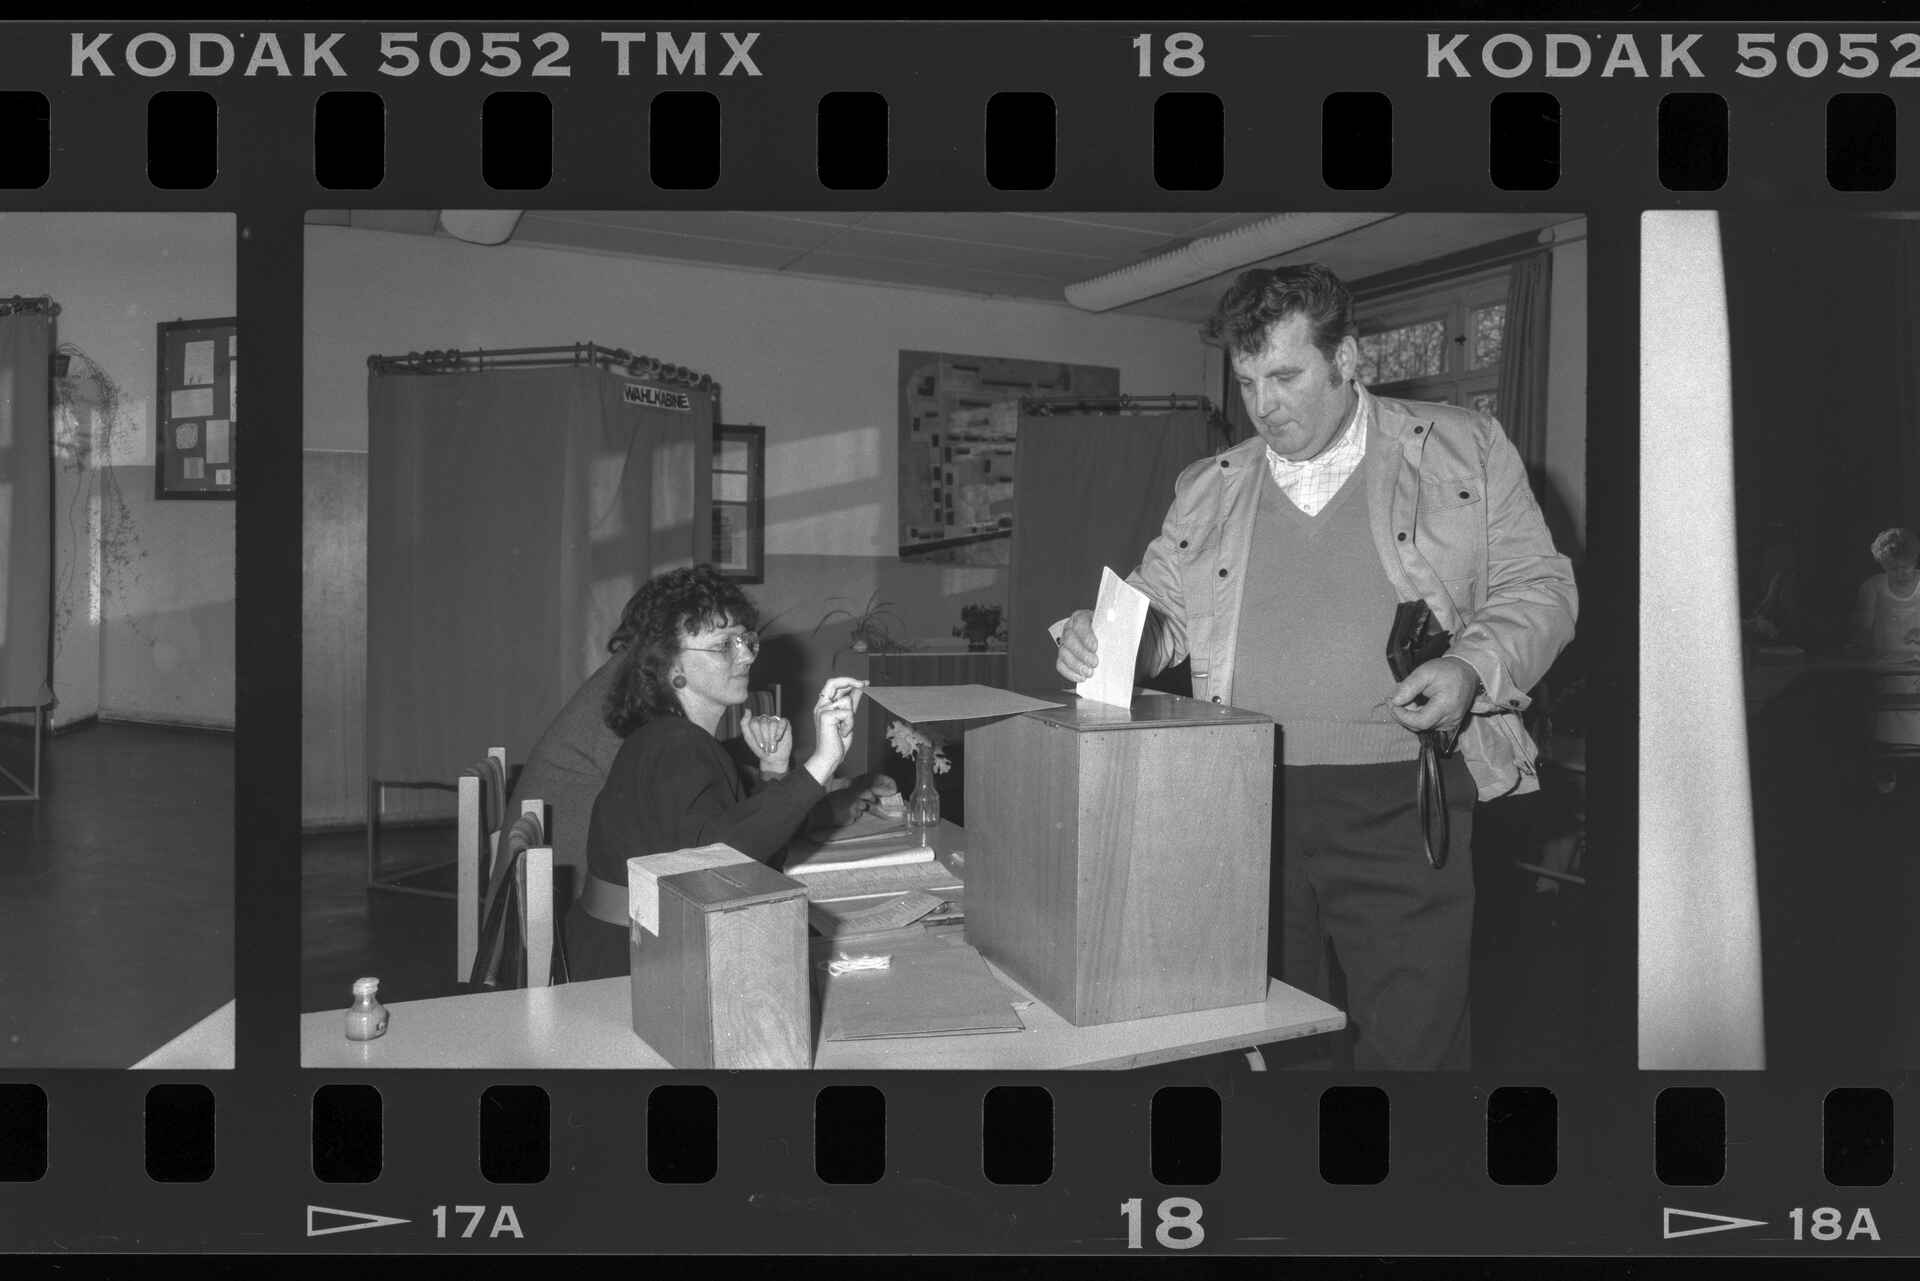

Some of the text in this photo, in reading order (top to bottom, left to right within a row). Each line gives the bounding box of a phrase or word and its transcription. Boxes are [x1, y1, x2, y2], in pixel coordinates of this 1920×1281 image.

[71, 31, 762, 77] KODAK 5052 TMX
[1133, 32, 1205, 77] 18
[1427, 32, 1920, 78] KODAK 5052
[624, 386, 689, 408] WAHLKABINE
[432, 1205, 524, 1238] 17A
[1120, 1197, 1205, 1250] 18
[1789, 1207, 1881, 1241] 18A
